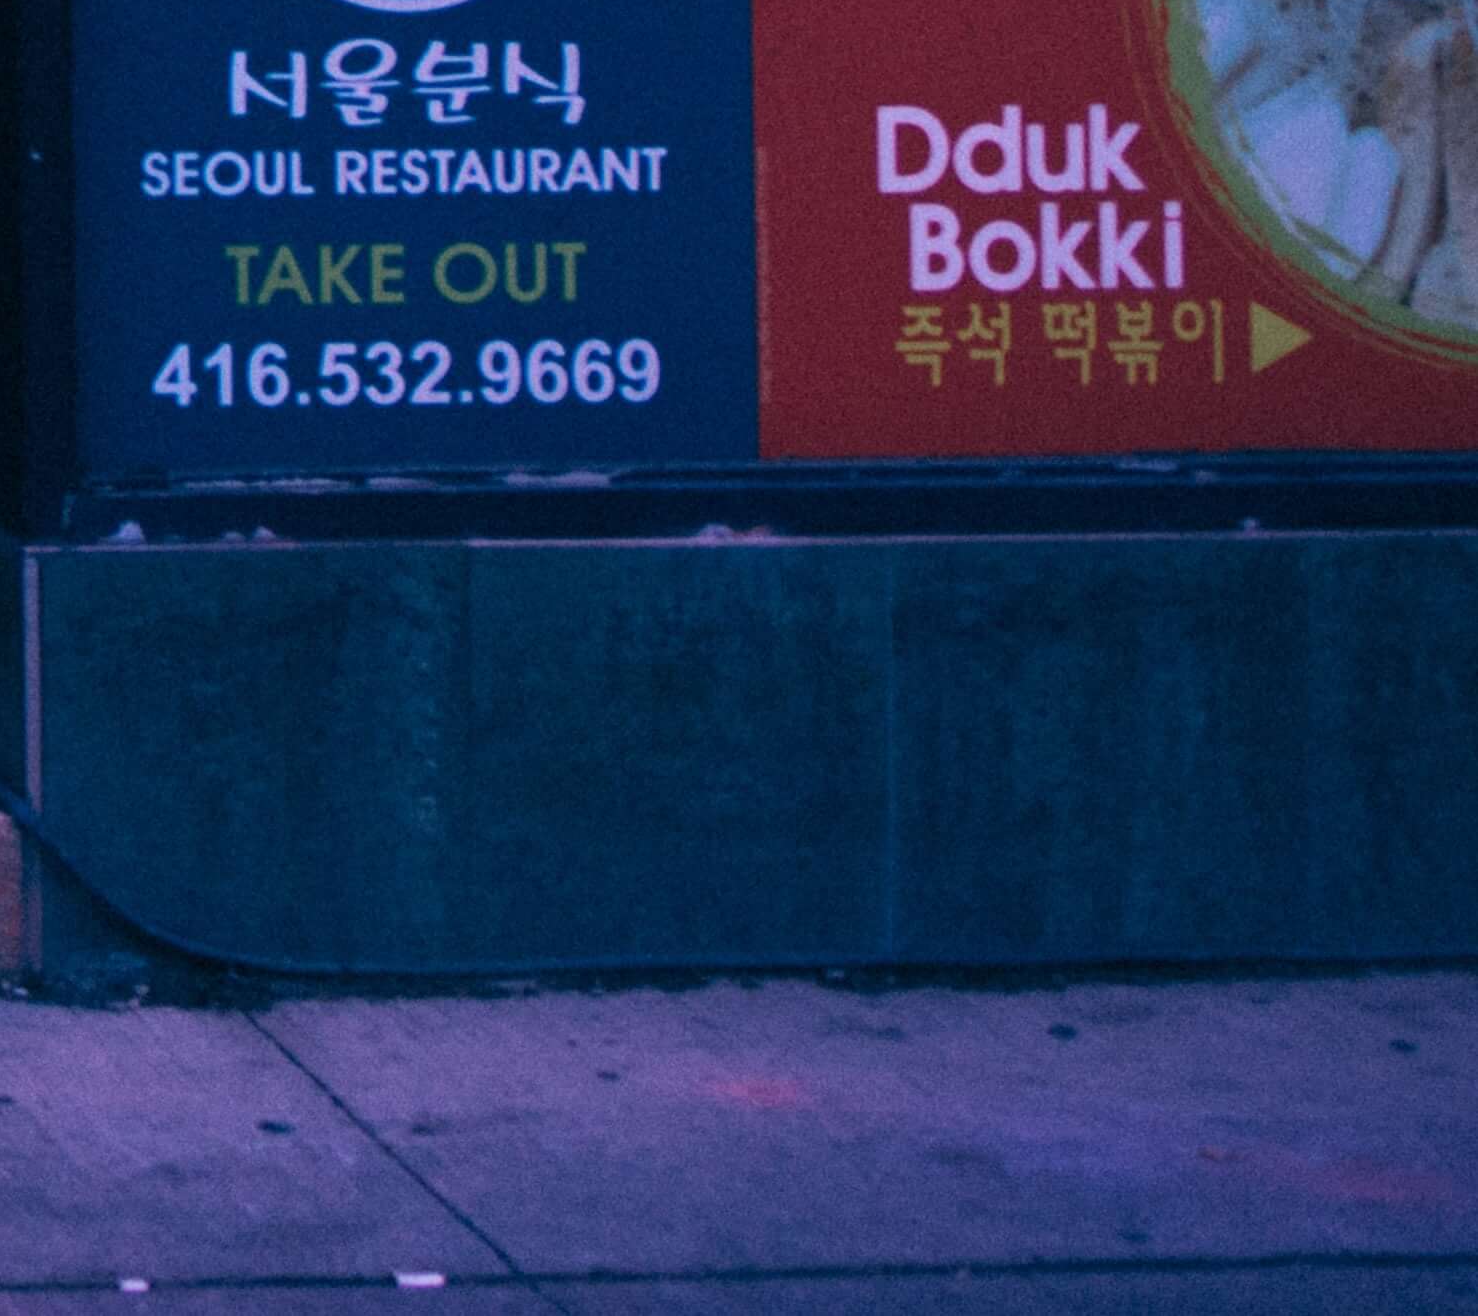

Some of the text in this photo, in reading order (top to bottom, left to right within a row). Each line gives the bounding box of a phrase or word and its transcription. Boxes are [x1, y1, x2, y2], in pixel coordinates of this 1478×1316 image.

[227, 37, 585, 127] 서울분식
[141, 148, 667, 198] SEOUL RESTAURANT
[876, 104, 1144, 195] Dduk
[224, 240, 588, 305] TAKE OUT
[907, 202, 1183, 293] Bokki
[151, 340, 660, 408] 416.532.9669
[894, 299, 1225, 387] 즉석 떡볶이
